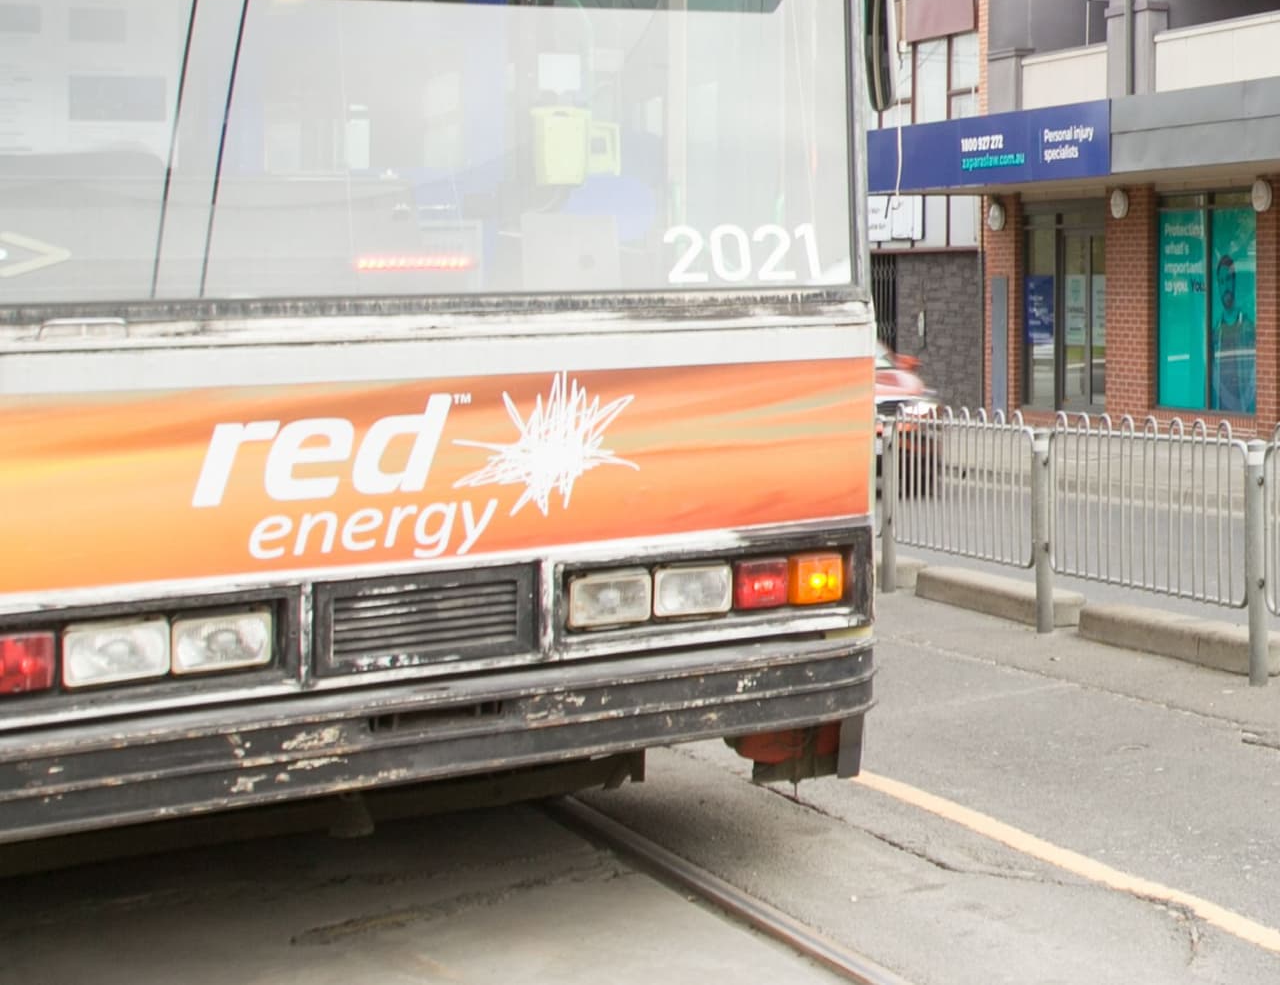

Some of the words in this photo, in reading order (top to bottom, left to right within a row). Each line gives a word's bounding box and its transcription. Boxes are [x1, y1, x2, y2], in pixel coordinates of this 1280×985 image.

[1043, 125, 1073, 143] Personal
[1073, 125, 1094, 142] injury
[1043, 144, 1079, 162] specialists
[663, 223, 822, 284] 2021
[191, 392, 452, 508] red
[248, 498, 499, 560] energy
